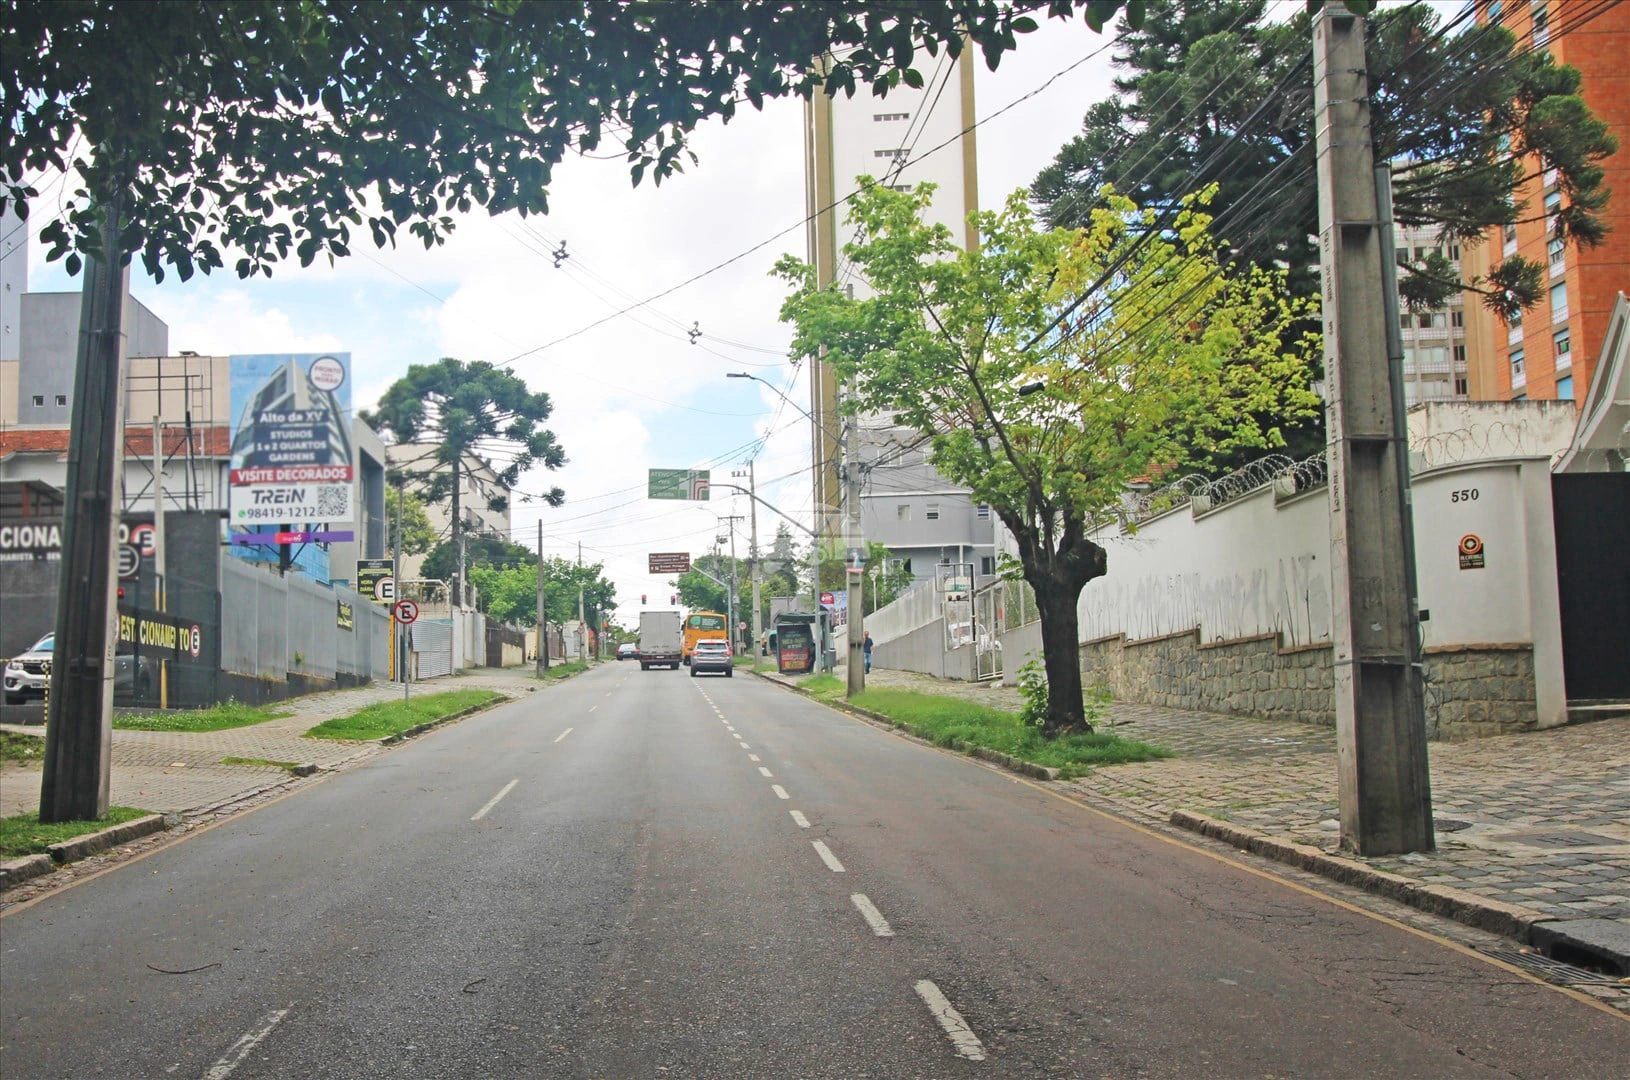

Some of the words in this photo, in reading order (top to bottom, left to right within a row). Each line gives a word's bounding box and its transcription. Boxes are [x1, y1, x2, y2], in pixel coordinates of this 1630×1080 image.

[260, 411, 286, 423] Alto
[288, 412, 303, 423] da
[306, 411, 323, 422] XV
[270, 430, 313, 440] STUDIOS
[272, 442, 278, 450] 2
[279, 440, 327, 450] QUARTOS
[268, 452, 315, 462] GARDENS
[238, 471, 274, 482] VISITE
[277, 468, 347, 480] DECORADOS
[1451, 488, 1479, 503] 550
[248, 507, 315, 519] 98419-1212
[382, 583, 393, 598] E
[121, 615, 190, 651] ESTCIONAMETO
[193, 631, 199, 650] E
